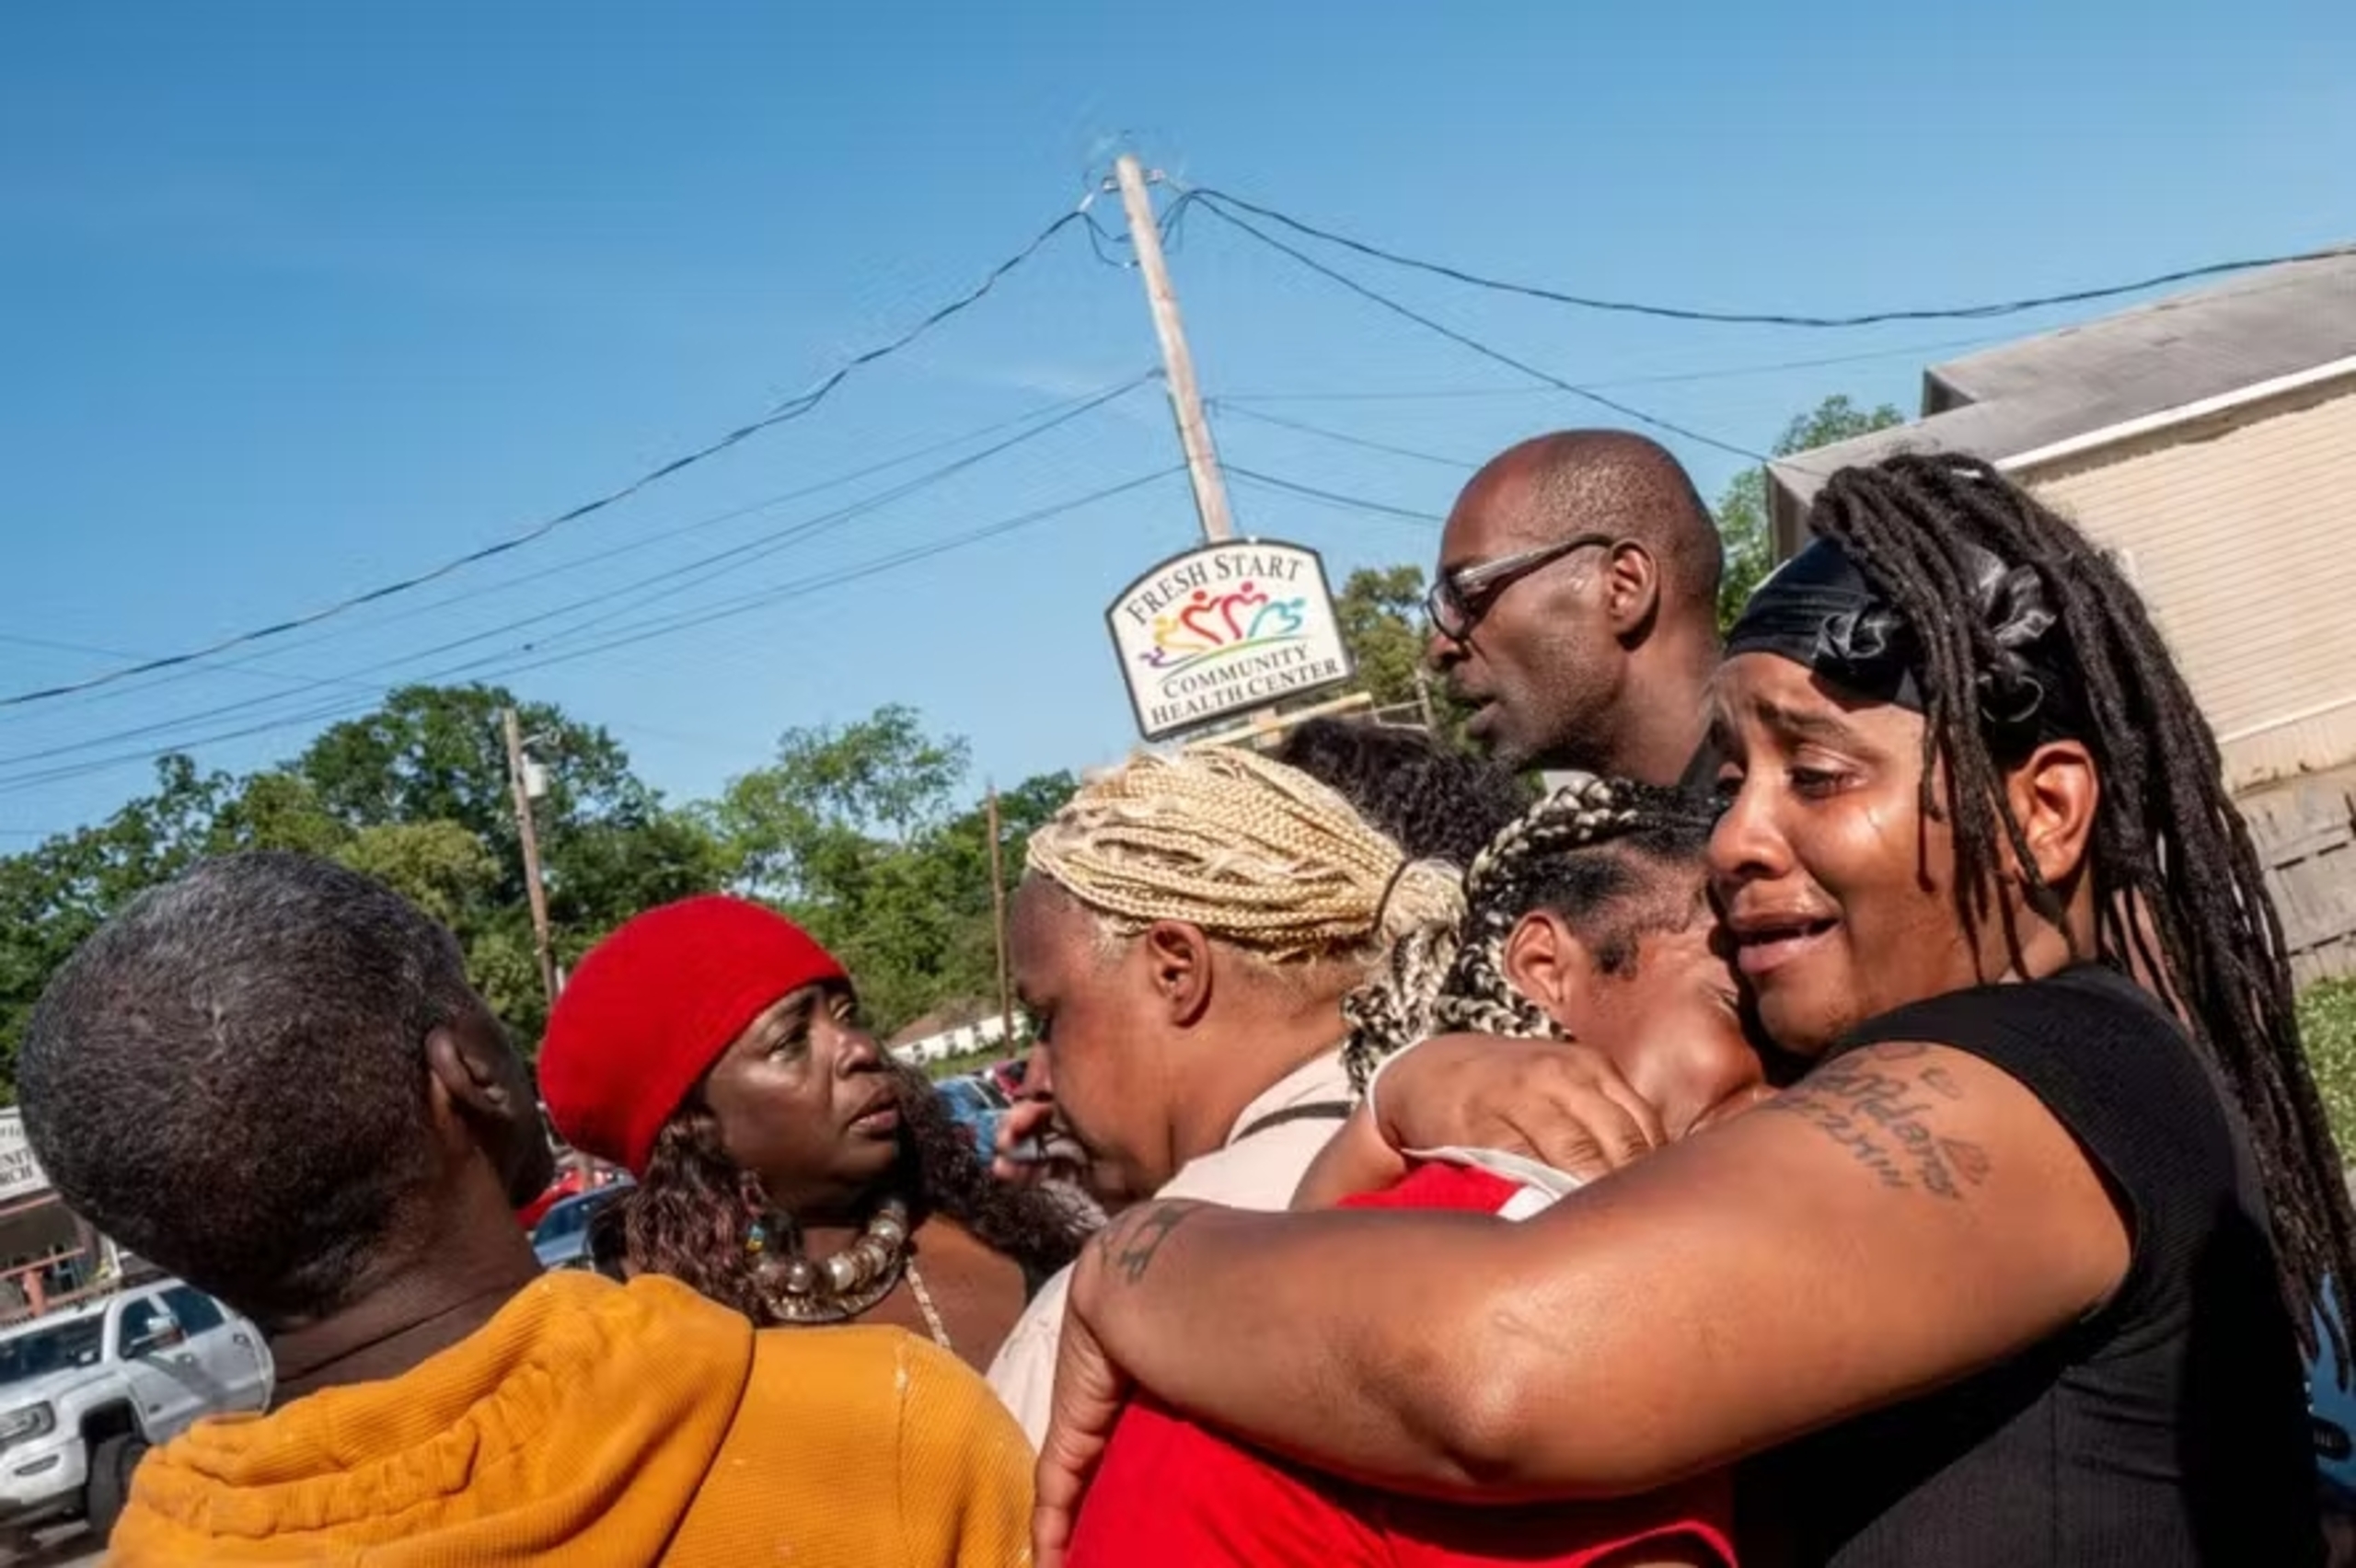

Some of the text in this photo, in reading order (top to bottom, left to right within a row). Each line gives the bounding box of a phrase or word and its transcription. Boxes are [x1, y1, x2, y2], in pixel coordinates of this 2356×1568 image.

[1126, 554, 1302, 626] FRESH START
[1152, 660, 1338, 725] HEALTH CENTER
[1163, 645, 1309, 699] COMMUNITY
